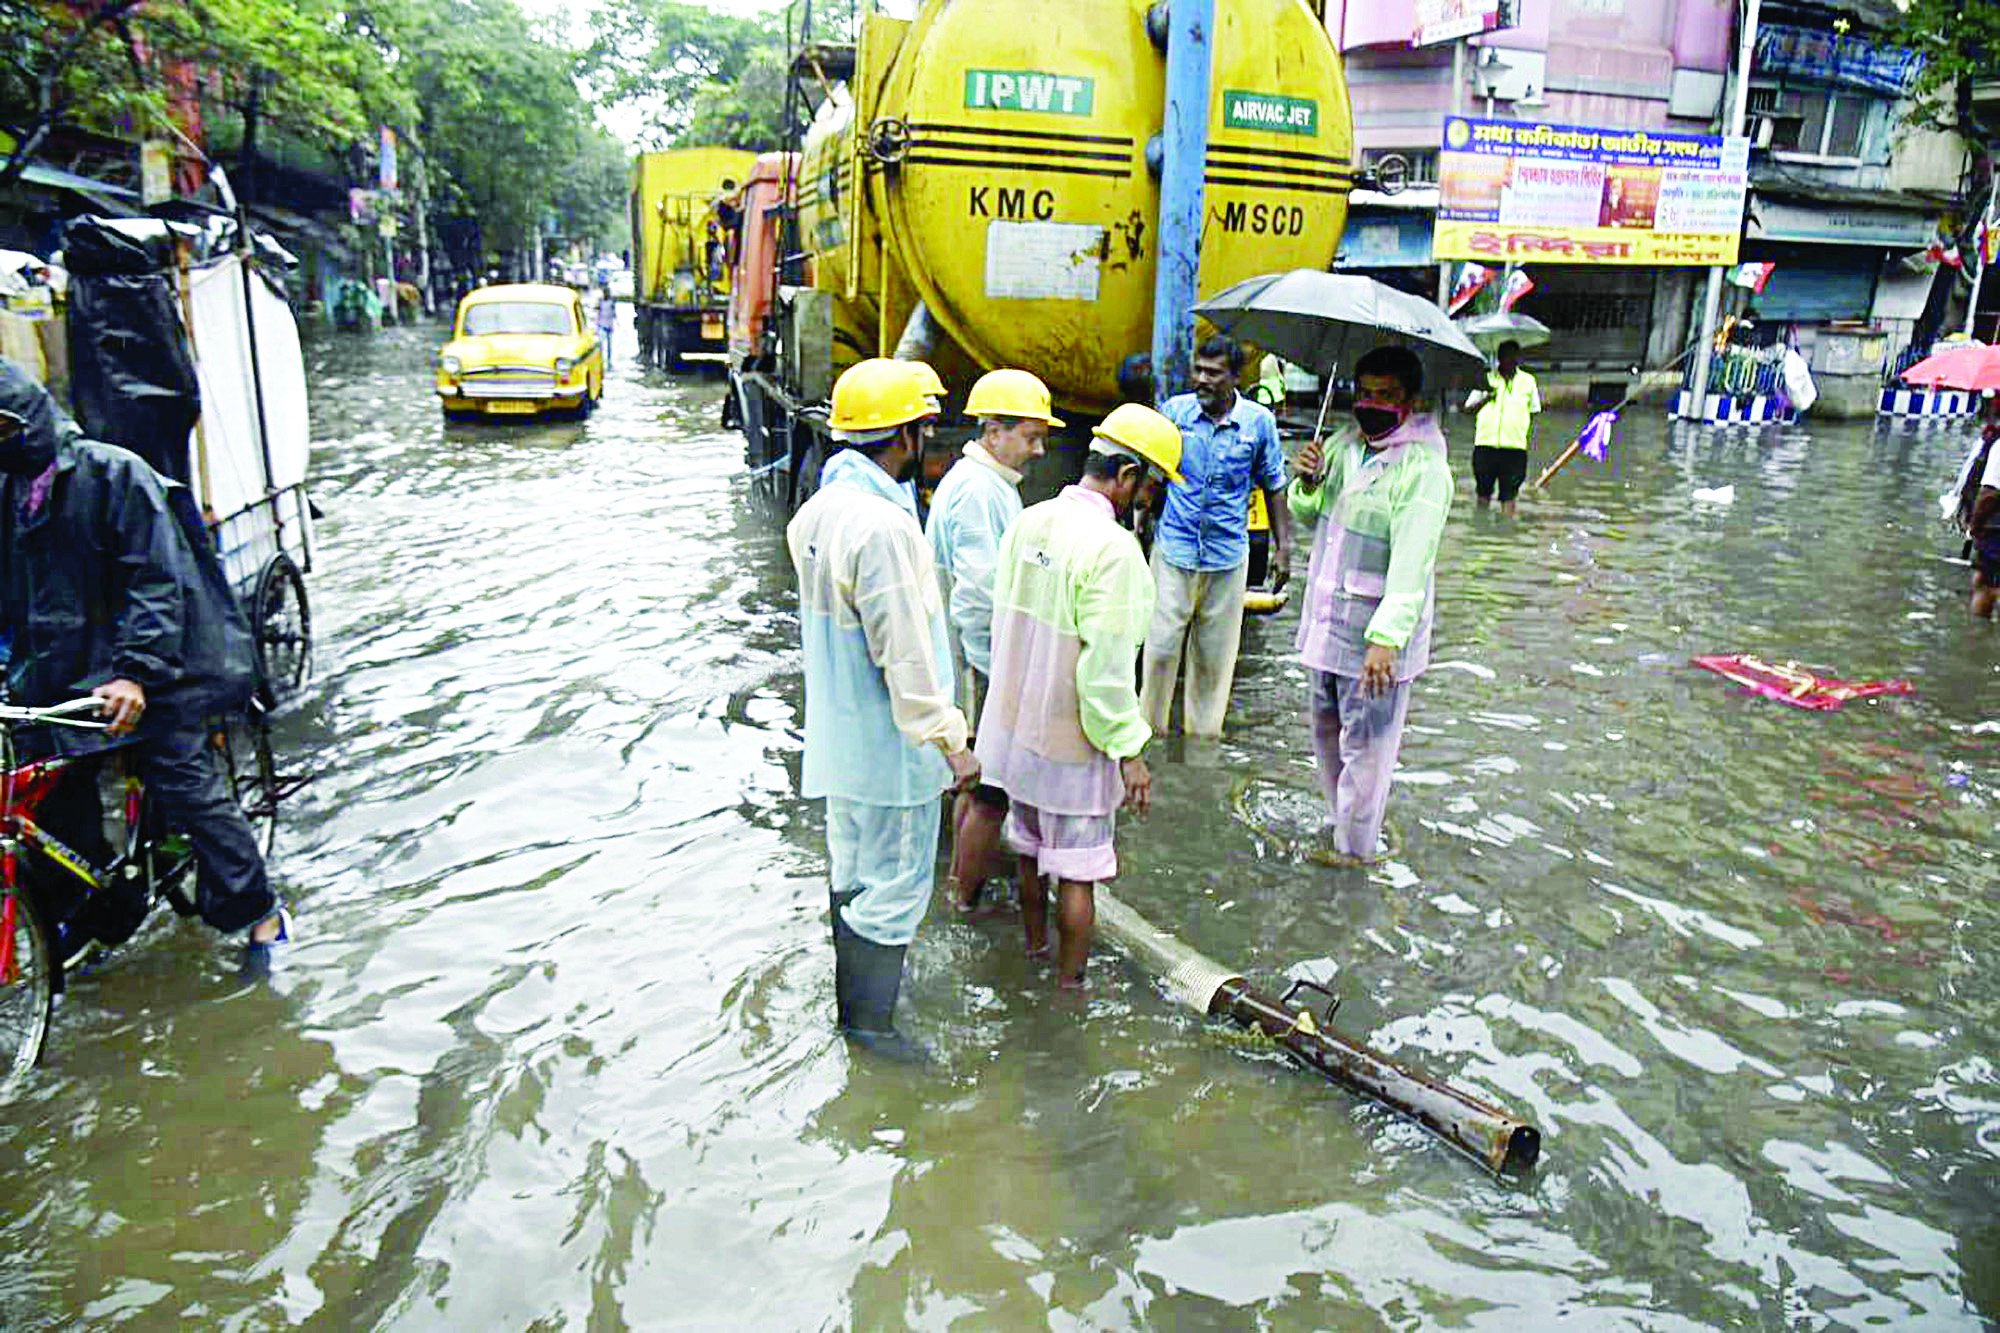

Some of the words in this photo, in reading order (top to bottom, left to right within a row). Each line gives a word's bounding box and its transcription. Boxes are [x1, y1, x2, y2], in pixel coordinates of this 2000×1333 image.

[975, 72, 1082, 112] IPWT
[1233, 100, 1284, 122] AIRVAC
[1286, 106, 1312, 126] JET
[970, 187, 1054, 220] KMC
[1224, 202, 1303, 237] MSCD
